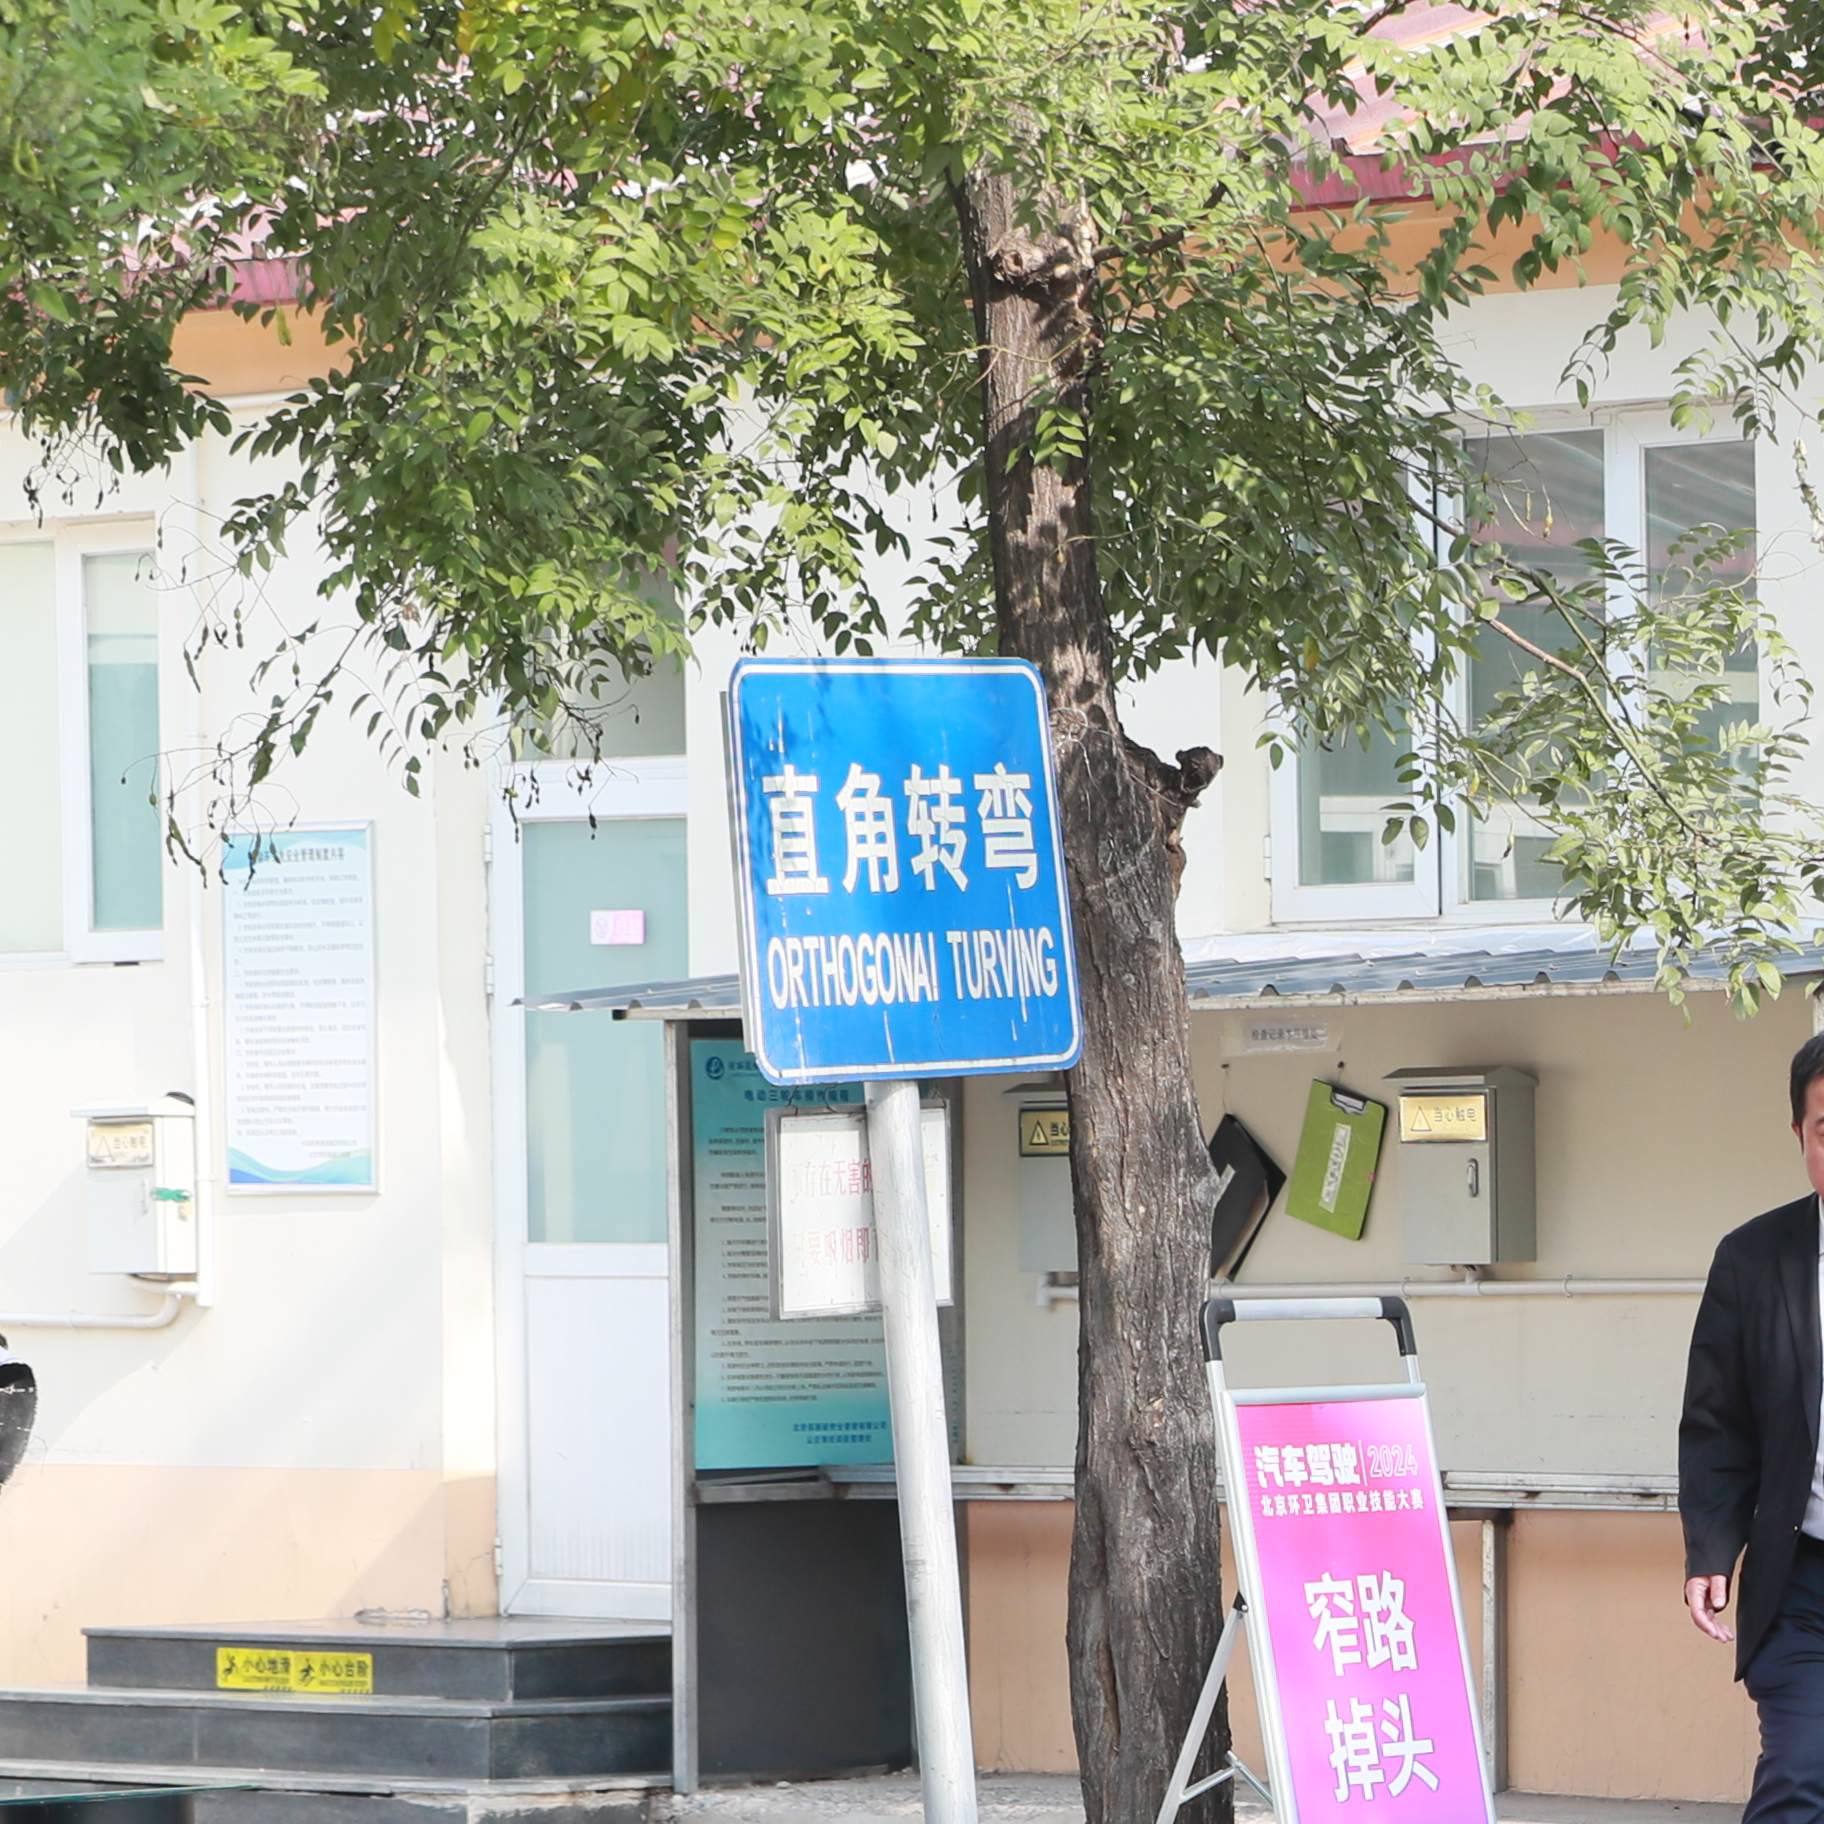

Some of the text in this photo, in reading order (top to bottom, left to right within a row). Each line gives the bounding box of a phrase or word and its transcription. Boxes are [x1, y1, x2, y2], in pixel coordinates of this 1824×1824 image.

[762, 762, 1039, 897] 直角转弯
[946, 926, 1059, 1000] TURVING
[1253, 1441, 1419, 1489] 汽车驾驶 2024
[1260, 1488, 1425, 1518] 北京环卫集团职业技能大赛
[1304, 1570, 1416, 1677] 窄路
[242, 1655, 290, 1675] 小心地滑
[319, 1660, 369, 1678] 小心台阶
[1324, 1691, 1441, 1803] 掉头
